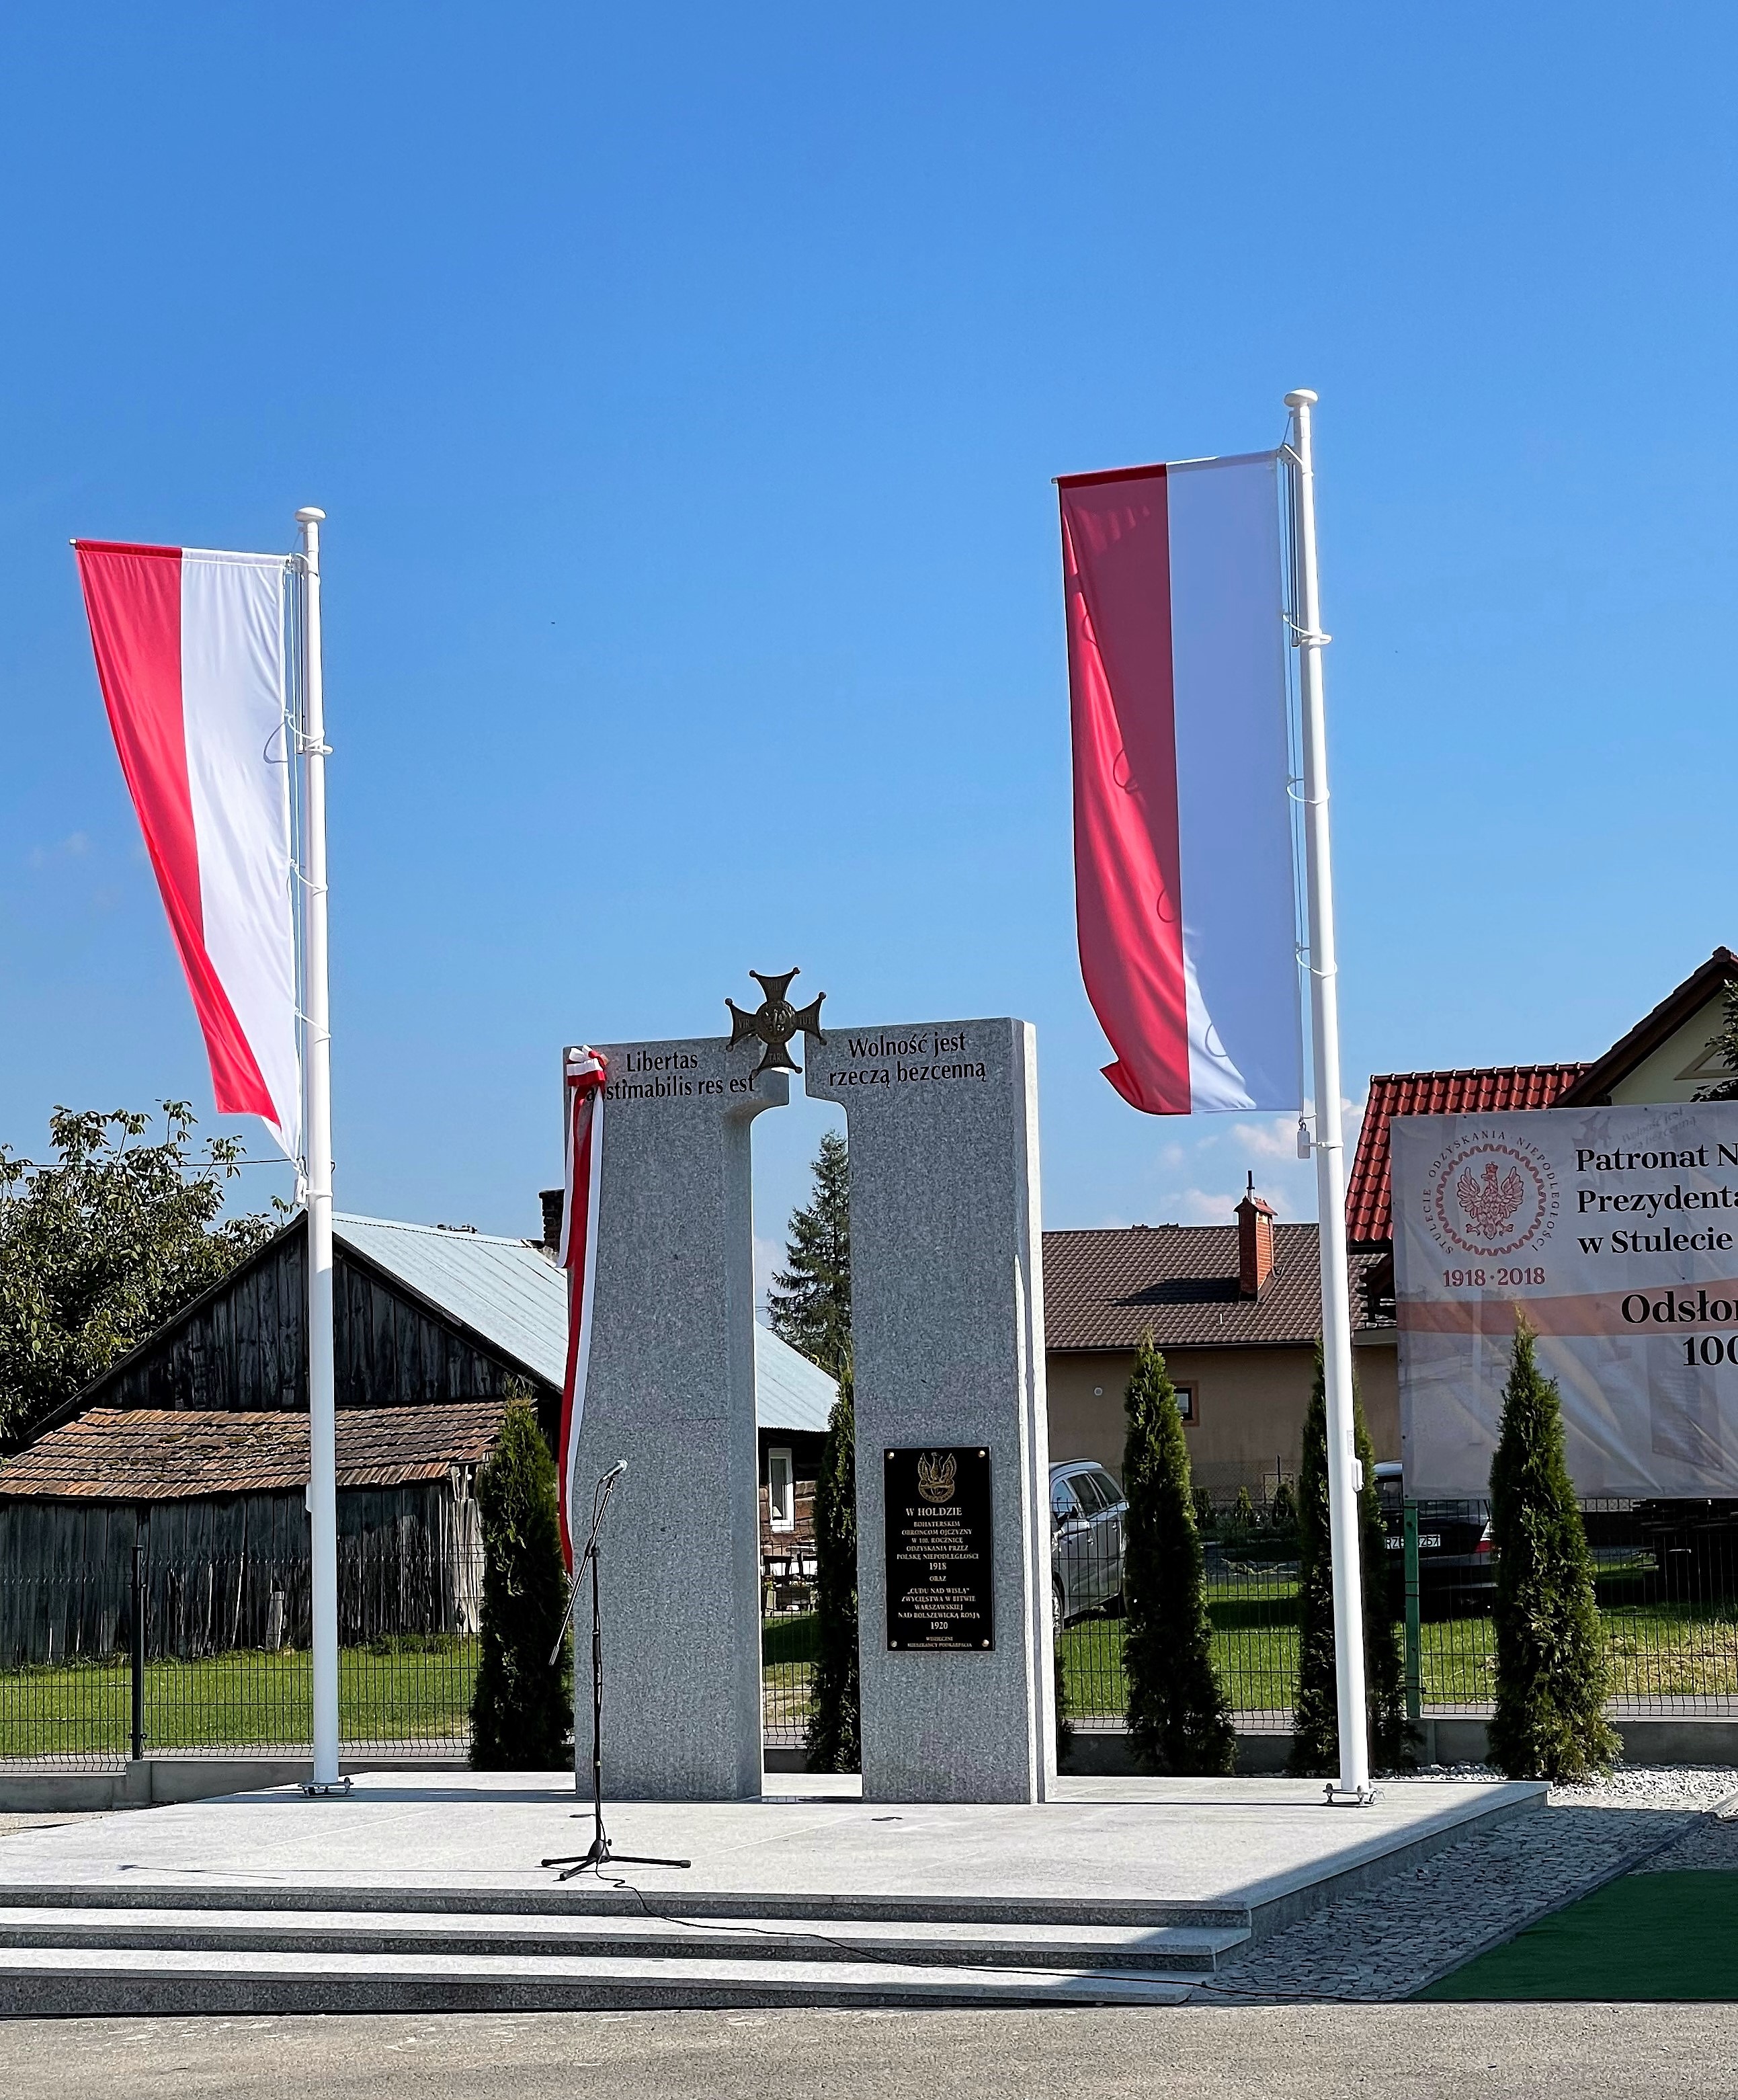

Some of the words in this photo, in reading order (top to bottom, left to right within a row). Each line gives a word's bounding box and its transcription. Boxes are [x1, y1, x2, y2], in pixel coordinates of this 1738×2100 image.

[848, 1033, 927, 1058] Wolność
[934, 1032, 966, 1057] jest
[626, 1051, 698, 1072] Libertas
[829, 1069, 890, 1088] rzeczą
[897, 1061, 986, 1082] bezcenną
[698, 1077, 723, 1094] res
[729, 1076, 754, 1093] est
[1428, 1130, 1505, 1178] ODZYSKANIA
[1575, 1141, 1710, 1172] Patronat
[1716, 1143, 1738, 1166] N
[1577, 1184, 1738, 1219] Prezydent
[1423, 1188, 1454, 1254] STULECIE
[1577, 1237, 1604, 1254] w
[1611, 1227, 1733, 1254] Stulecie
[1442, 1268, 1486, 1287] 1918
[1497, 1266, 1546, 1285] 2018
[1621, 1290, 1738, 1324] Odsło
[905, 1508, 915, 1516] W
[929, 1562, 947, 1570] 1918
[931, 1621, 948, 1629] 1920
